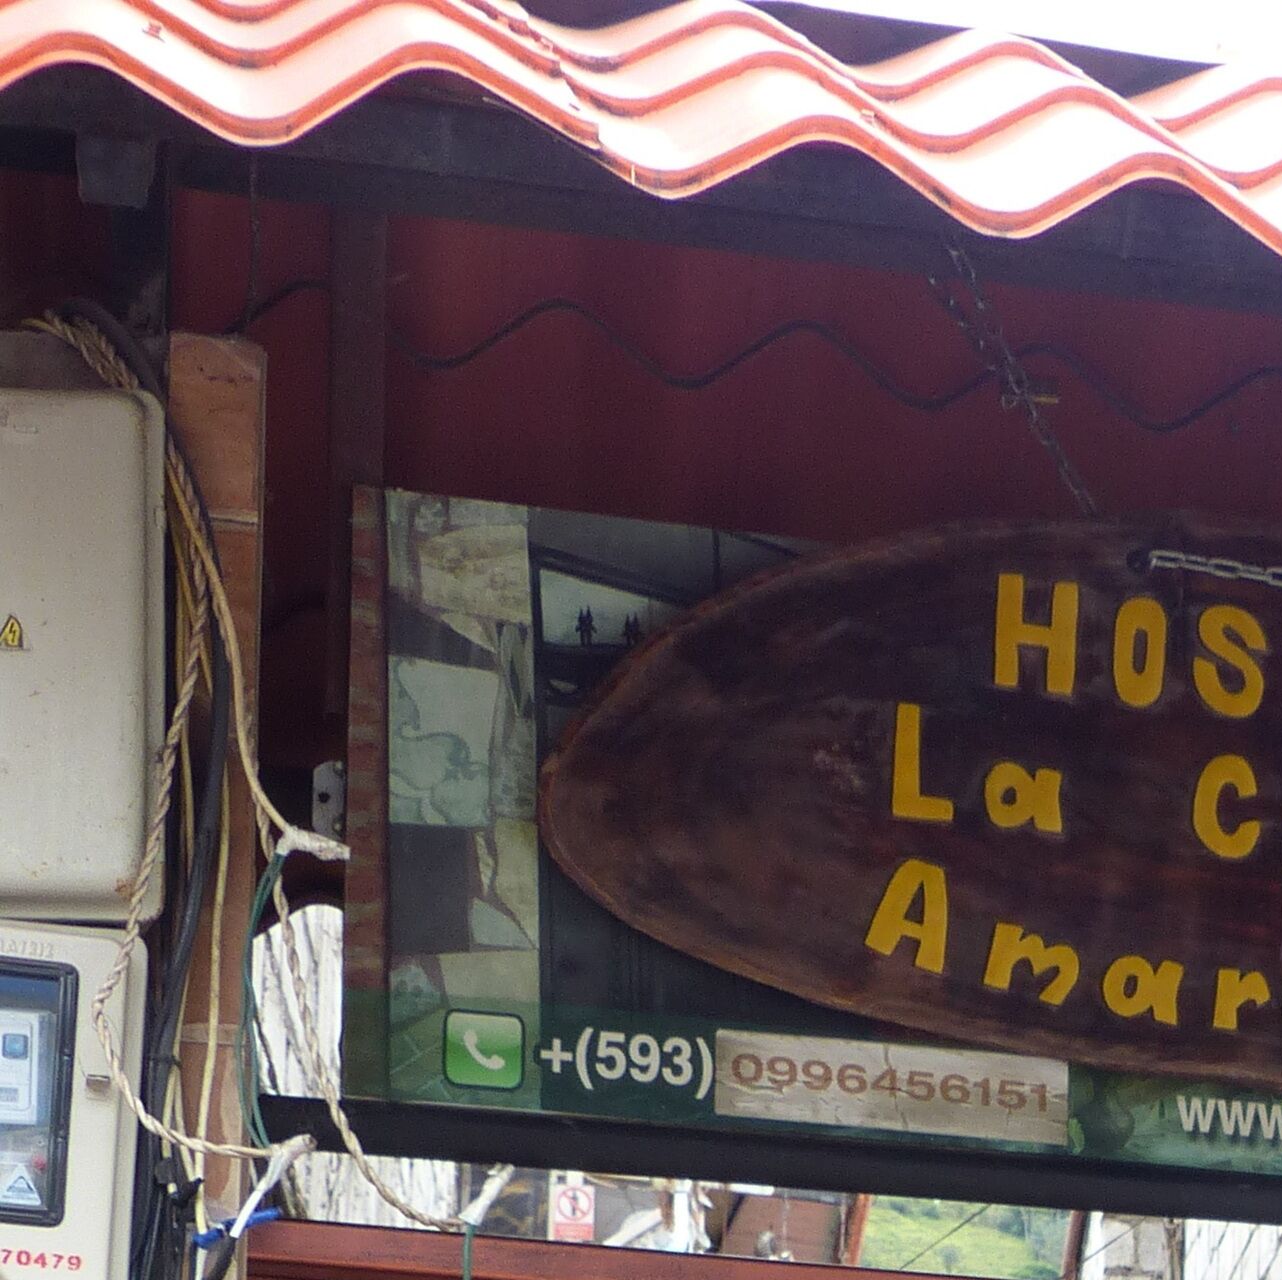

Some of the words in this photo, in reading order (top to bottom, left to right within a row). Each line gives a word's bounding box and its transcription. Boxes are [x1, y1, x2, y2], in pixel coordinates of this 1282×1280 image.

[891, 703, 1064, 834] La
[540, 1026, 713, 1099] +(593)
[731, 1053, 1050, 1112] 0996456151
